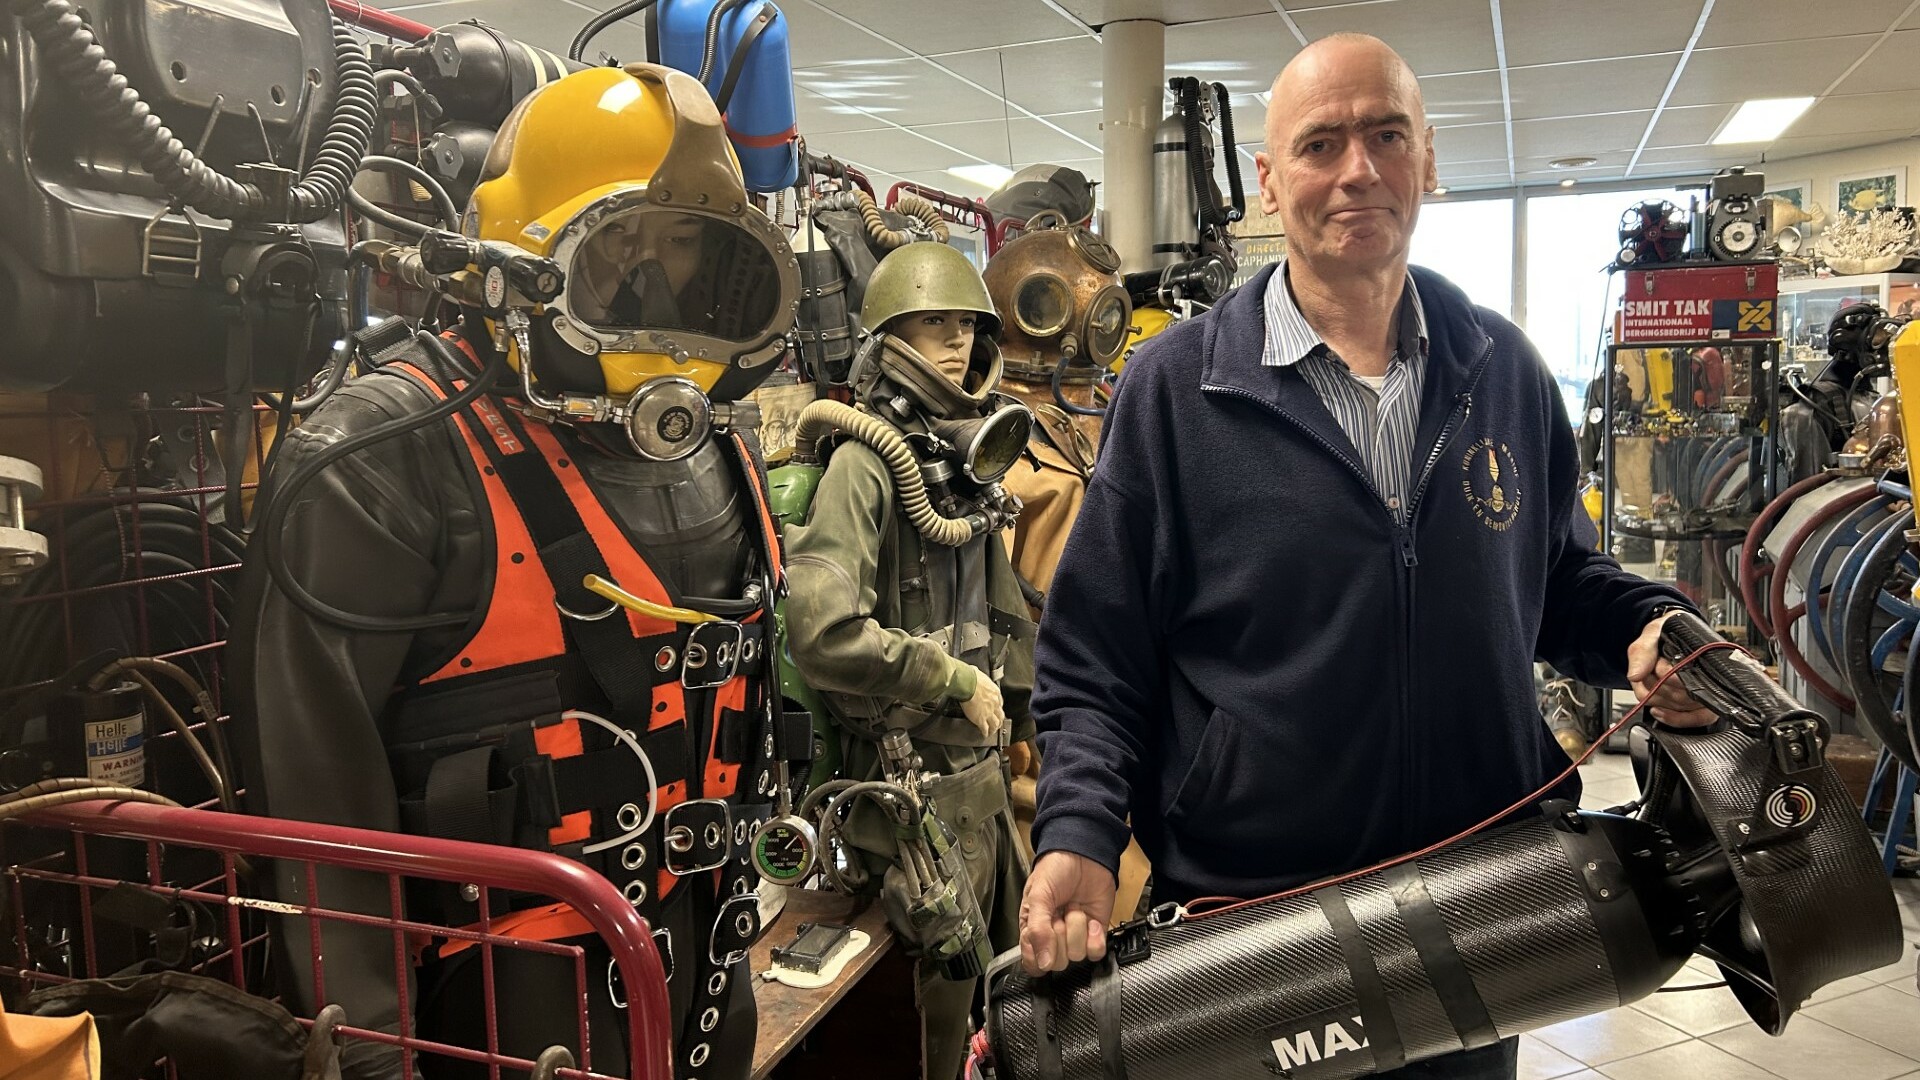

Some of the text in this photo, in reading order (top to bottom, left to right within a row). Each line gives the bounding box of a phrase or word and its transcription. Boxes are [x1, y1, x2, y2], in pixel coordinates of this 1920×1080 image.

[1625, 299, 1710, 317] SMIT TAK
[1625, 318, 1693, 327] INTERNATIONAAL
[1625, 329, 1696, 338] BERGINGSBEDRIJF
[1697, 328, 1709, 336] BV
[476, 402, 515, 451] VEST
